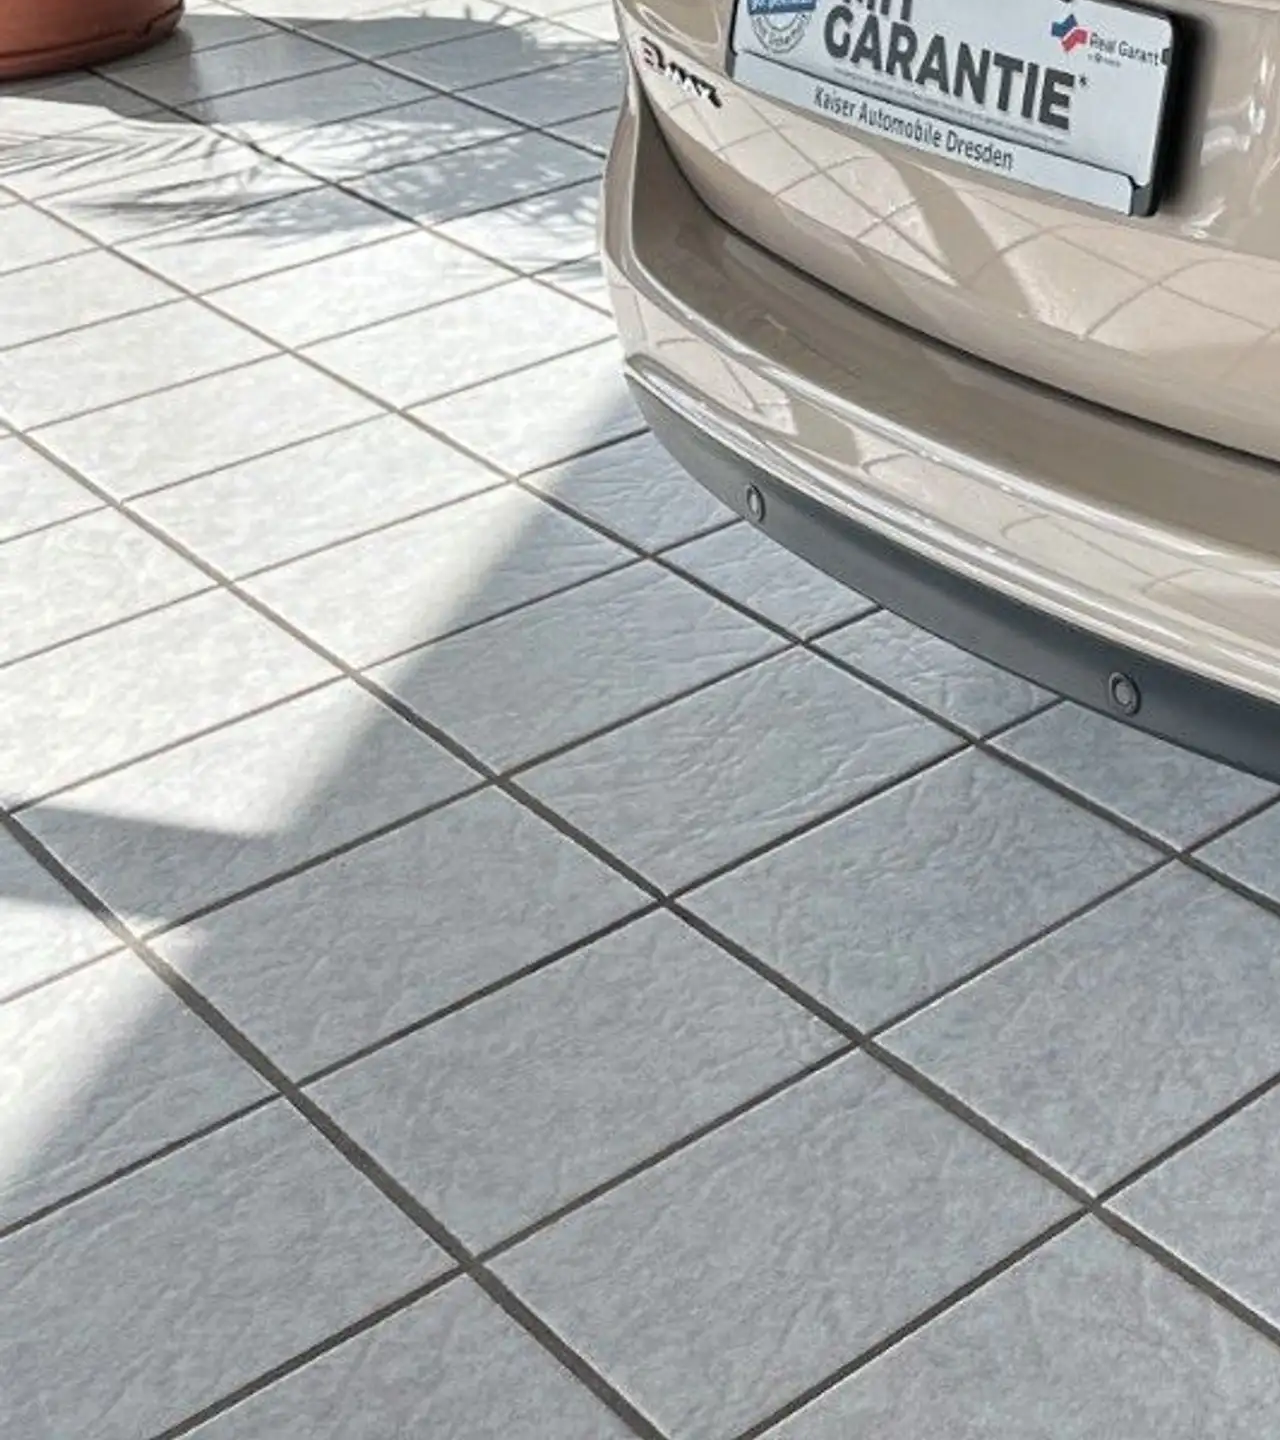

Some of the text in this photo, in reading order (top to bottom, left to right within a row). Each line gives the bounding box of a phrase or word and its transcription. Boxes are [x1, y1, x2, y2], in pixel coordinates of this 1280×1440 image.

[1118, 40, 1160, 67] Garant
[813, 85, 856, 118] Kaiser
[858, 102, 943, 148] Automobile
[946, 129, 1013, 171] Dresden
